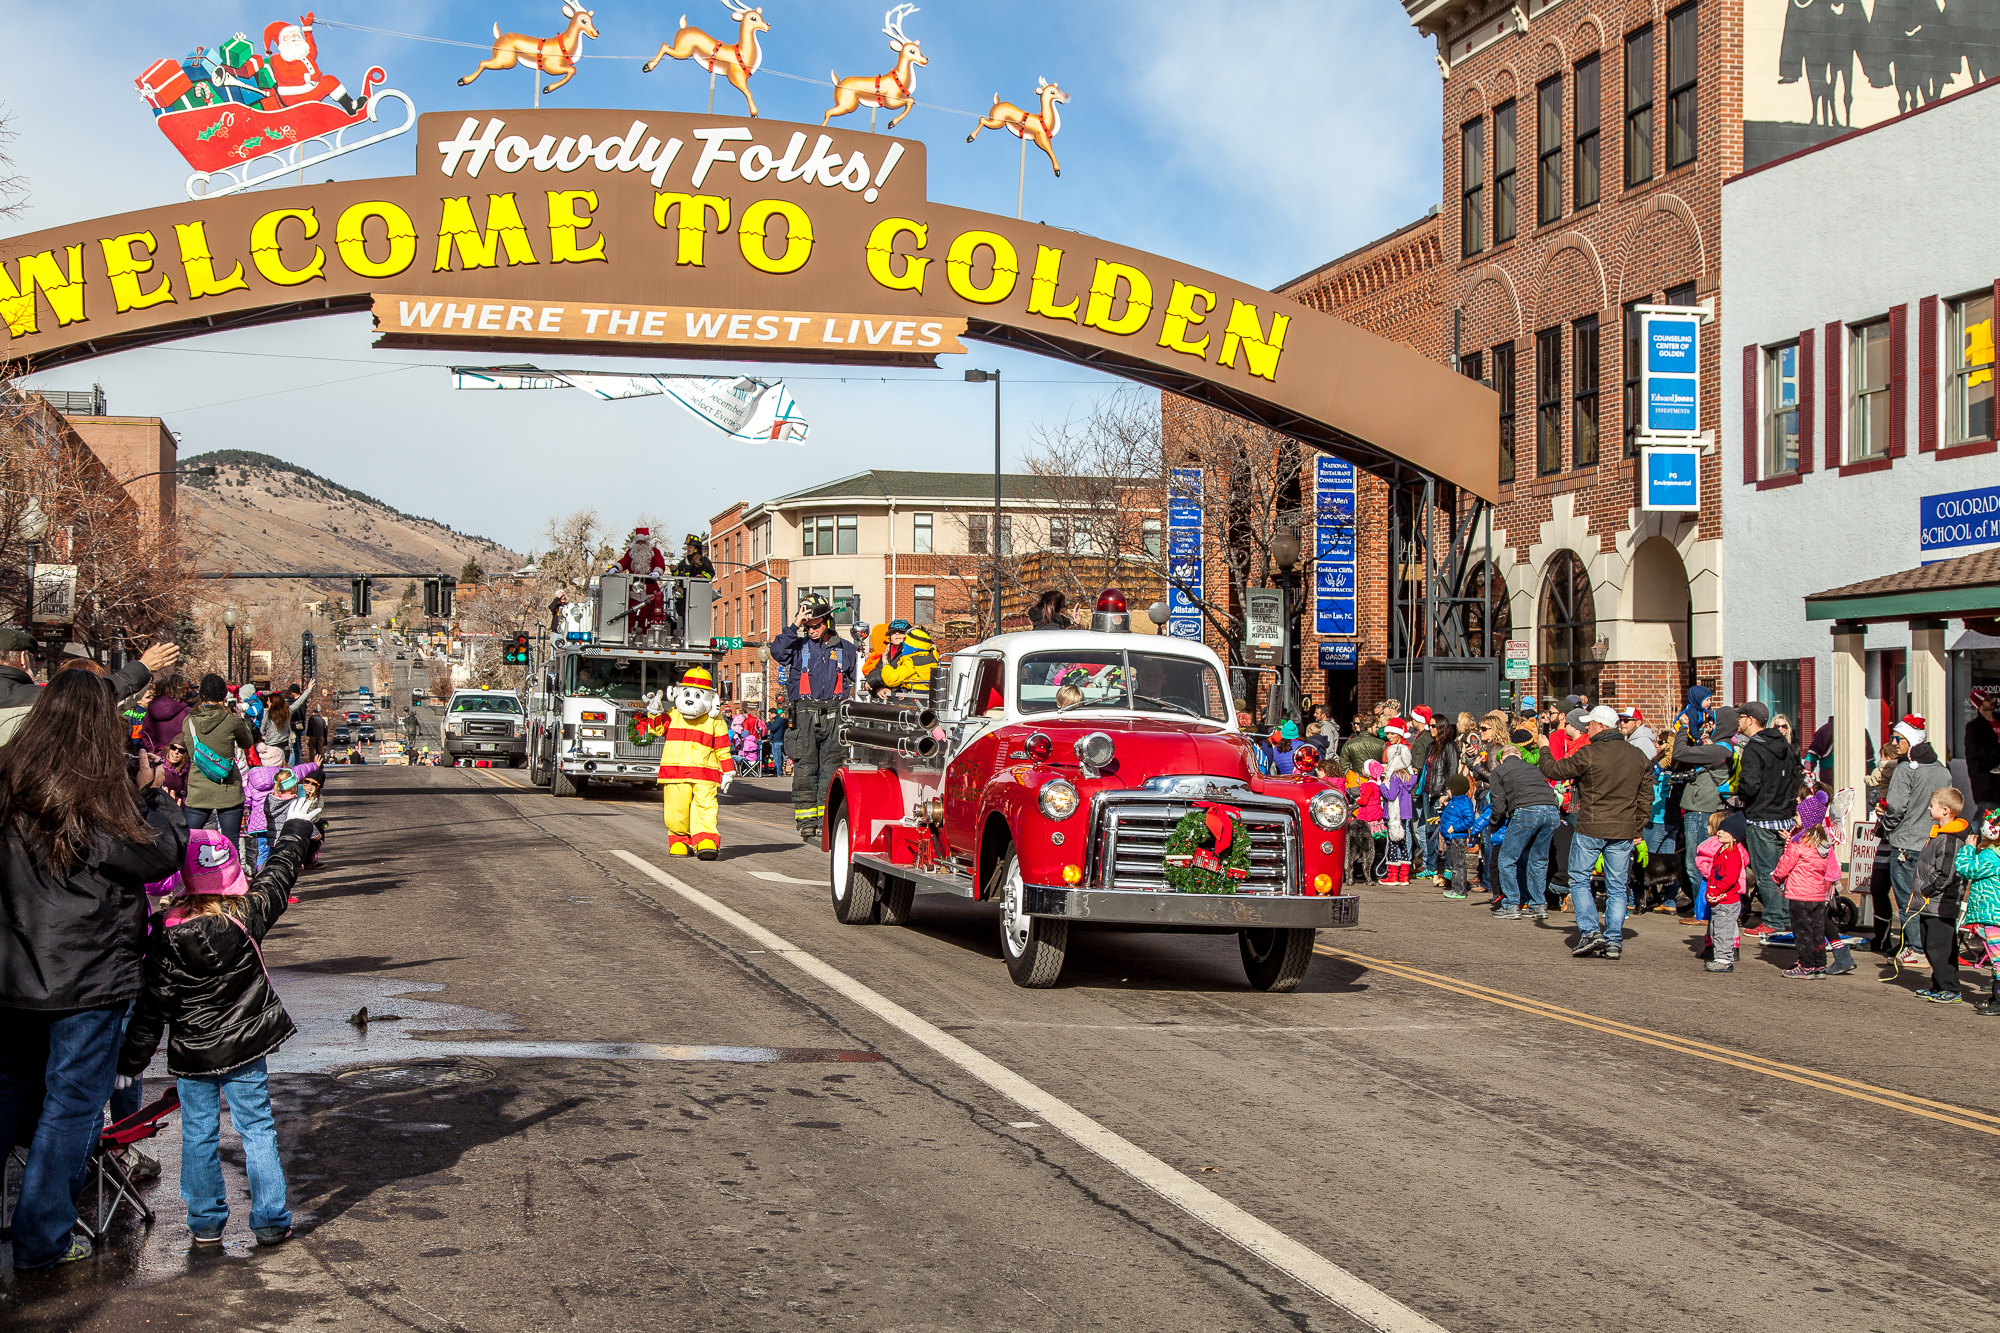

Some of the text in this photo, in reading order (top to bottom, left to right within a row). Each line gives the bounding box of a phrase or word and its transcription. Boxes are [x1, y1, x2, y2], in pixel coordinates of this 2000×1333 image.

[437, 116, 905, 203] Howdy Folks!
[0, 189, 1292, 382] WELCOME TO GOLDEN
[399, 301, 943, 348] WHERE THE WEST LIVES
[1653, 334, 1692, 343] COUNSELING
[1936, 495, 2000, 519] COLORAD
[1921, 523, 1972, 545] SCHOOL
[1974, 519, 1989, 539] of
[1171, 605, 1199, 614] Allstate
[732, 638, 741, 648] St
[954, 760, 982, 783] GOLDEN
[1174, 781, 1231, 796] GMC
[1864, 828, 1875, 842] NO
[1855, 863, 1872, 873] IN TH
[1855, 876, 1872, 887] BLOC
